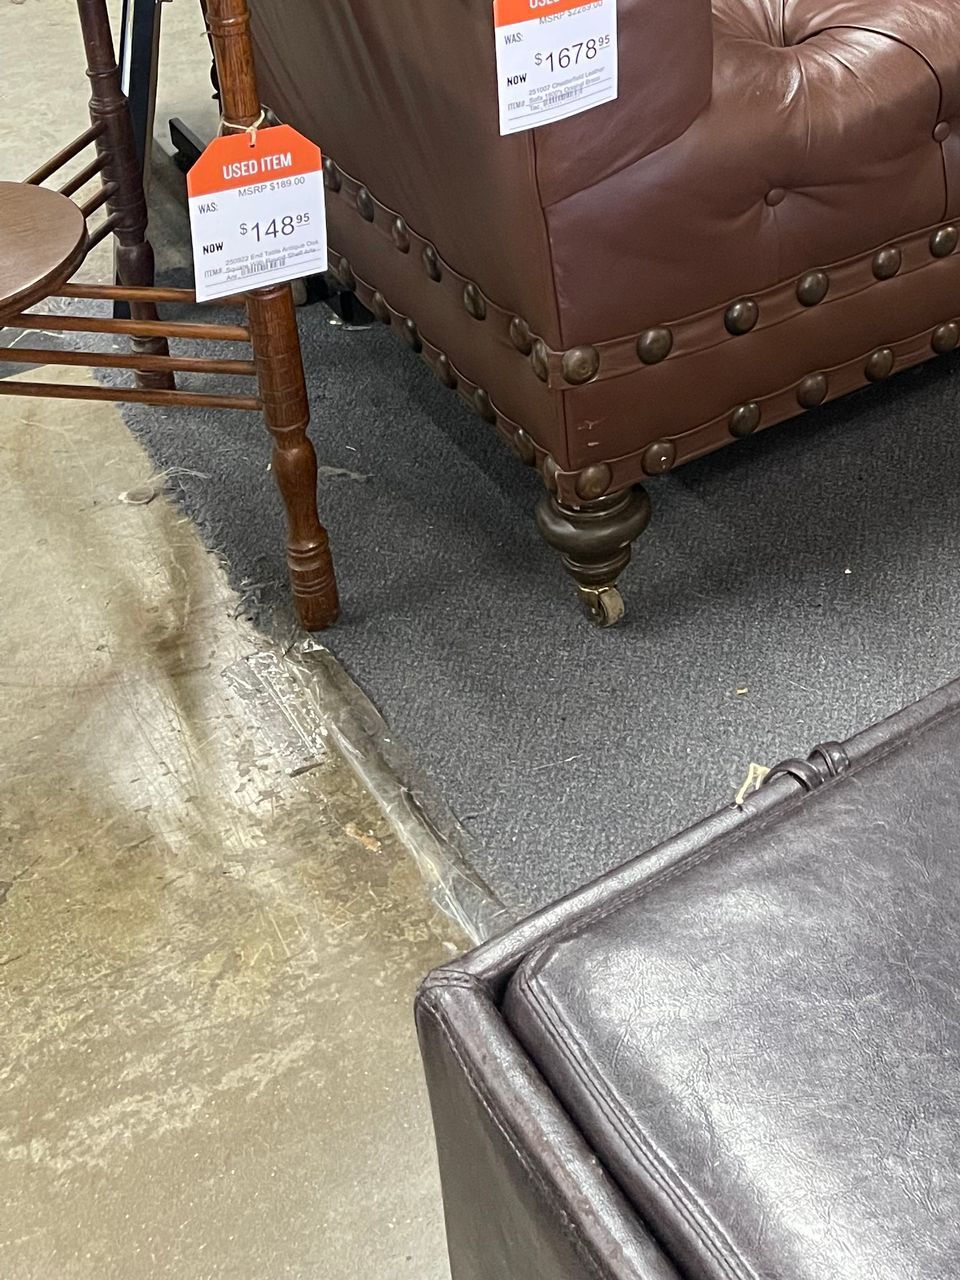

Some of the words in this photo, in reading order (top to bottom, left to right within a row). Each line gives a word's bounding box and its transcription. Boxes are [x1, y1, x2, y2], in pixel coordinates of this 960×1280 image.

[507, 73, 527, 87] NOW
[223, 160, 258, 179] USED
[261, 152, 292, 169] ITEM
[238, 185, 267, 197] MSRP
[269, 176, 305, 191] $189.00
[202, 242, 223, 255] NOW
